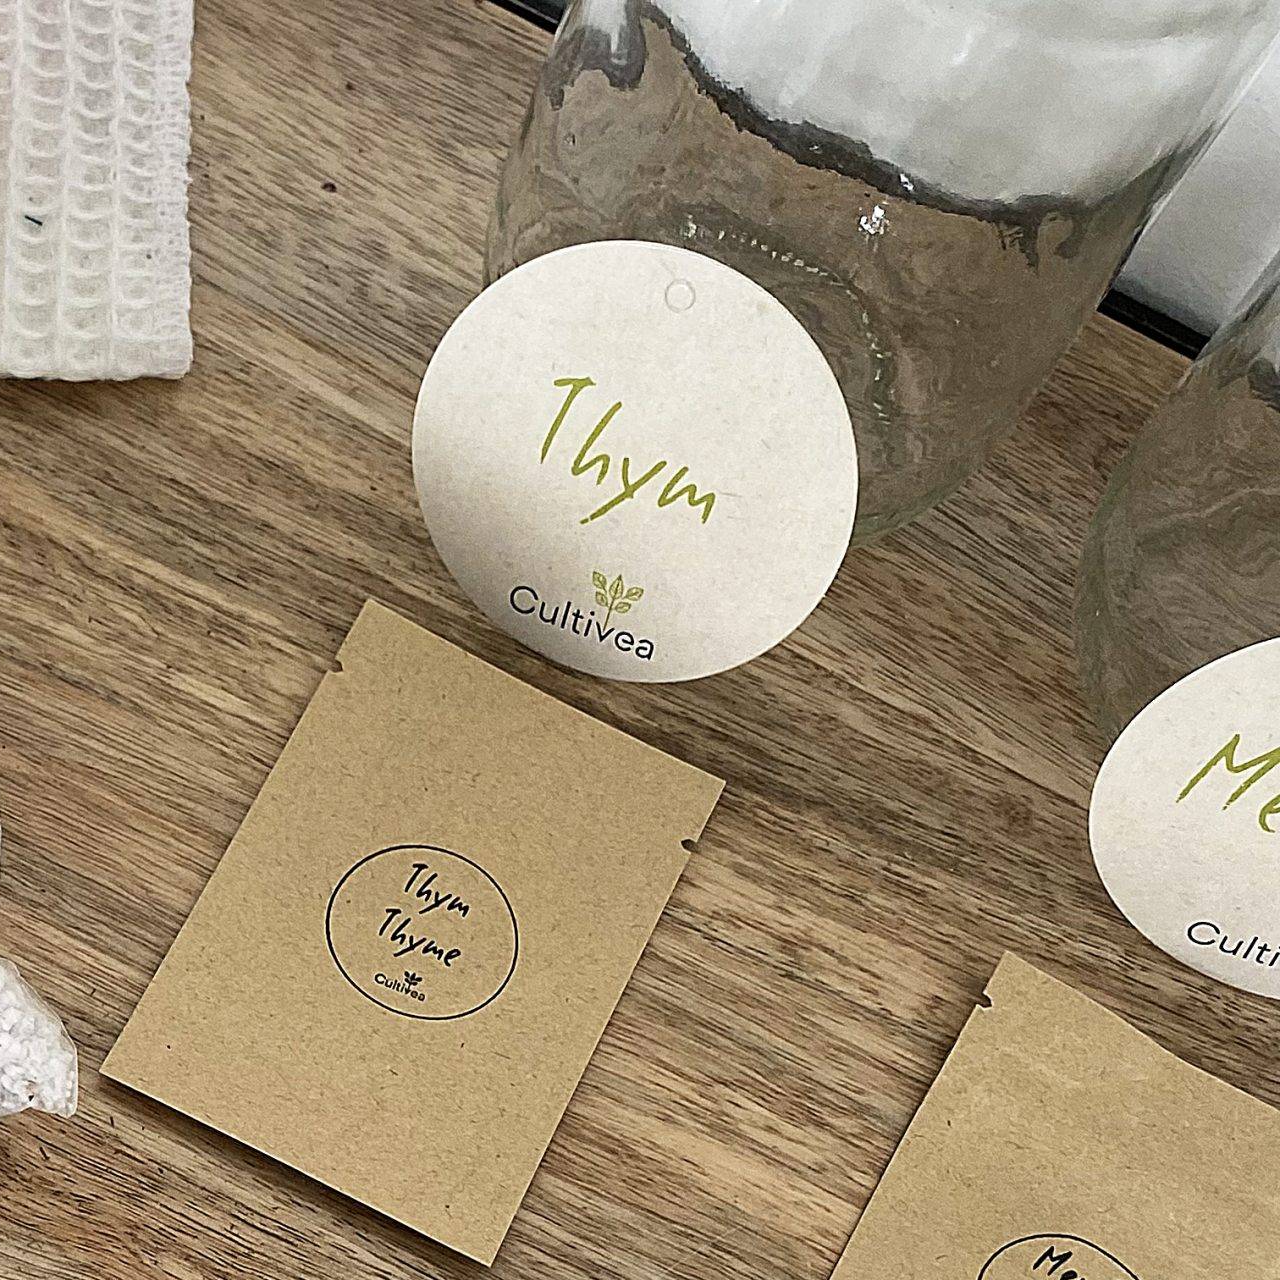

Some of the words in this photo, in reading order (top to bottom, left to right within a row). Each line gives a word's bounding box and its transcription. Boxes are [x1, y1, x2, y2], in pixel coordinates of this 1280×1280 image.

[540, 376, 716, 525] Thym
[509, 585, 655, 661] Cultivea
[404, 863, 470, 918] Thym
[378, 908, 462, 967] Thyme
[374, 972, 426, 1002] Cultivea
